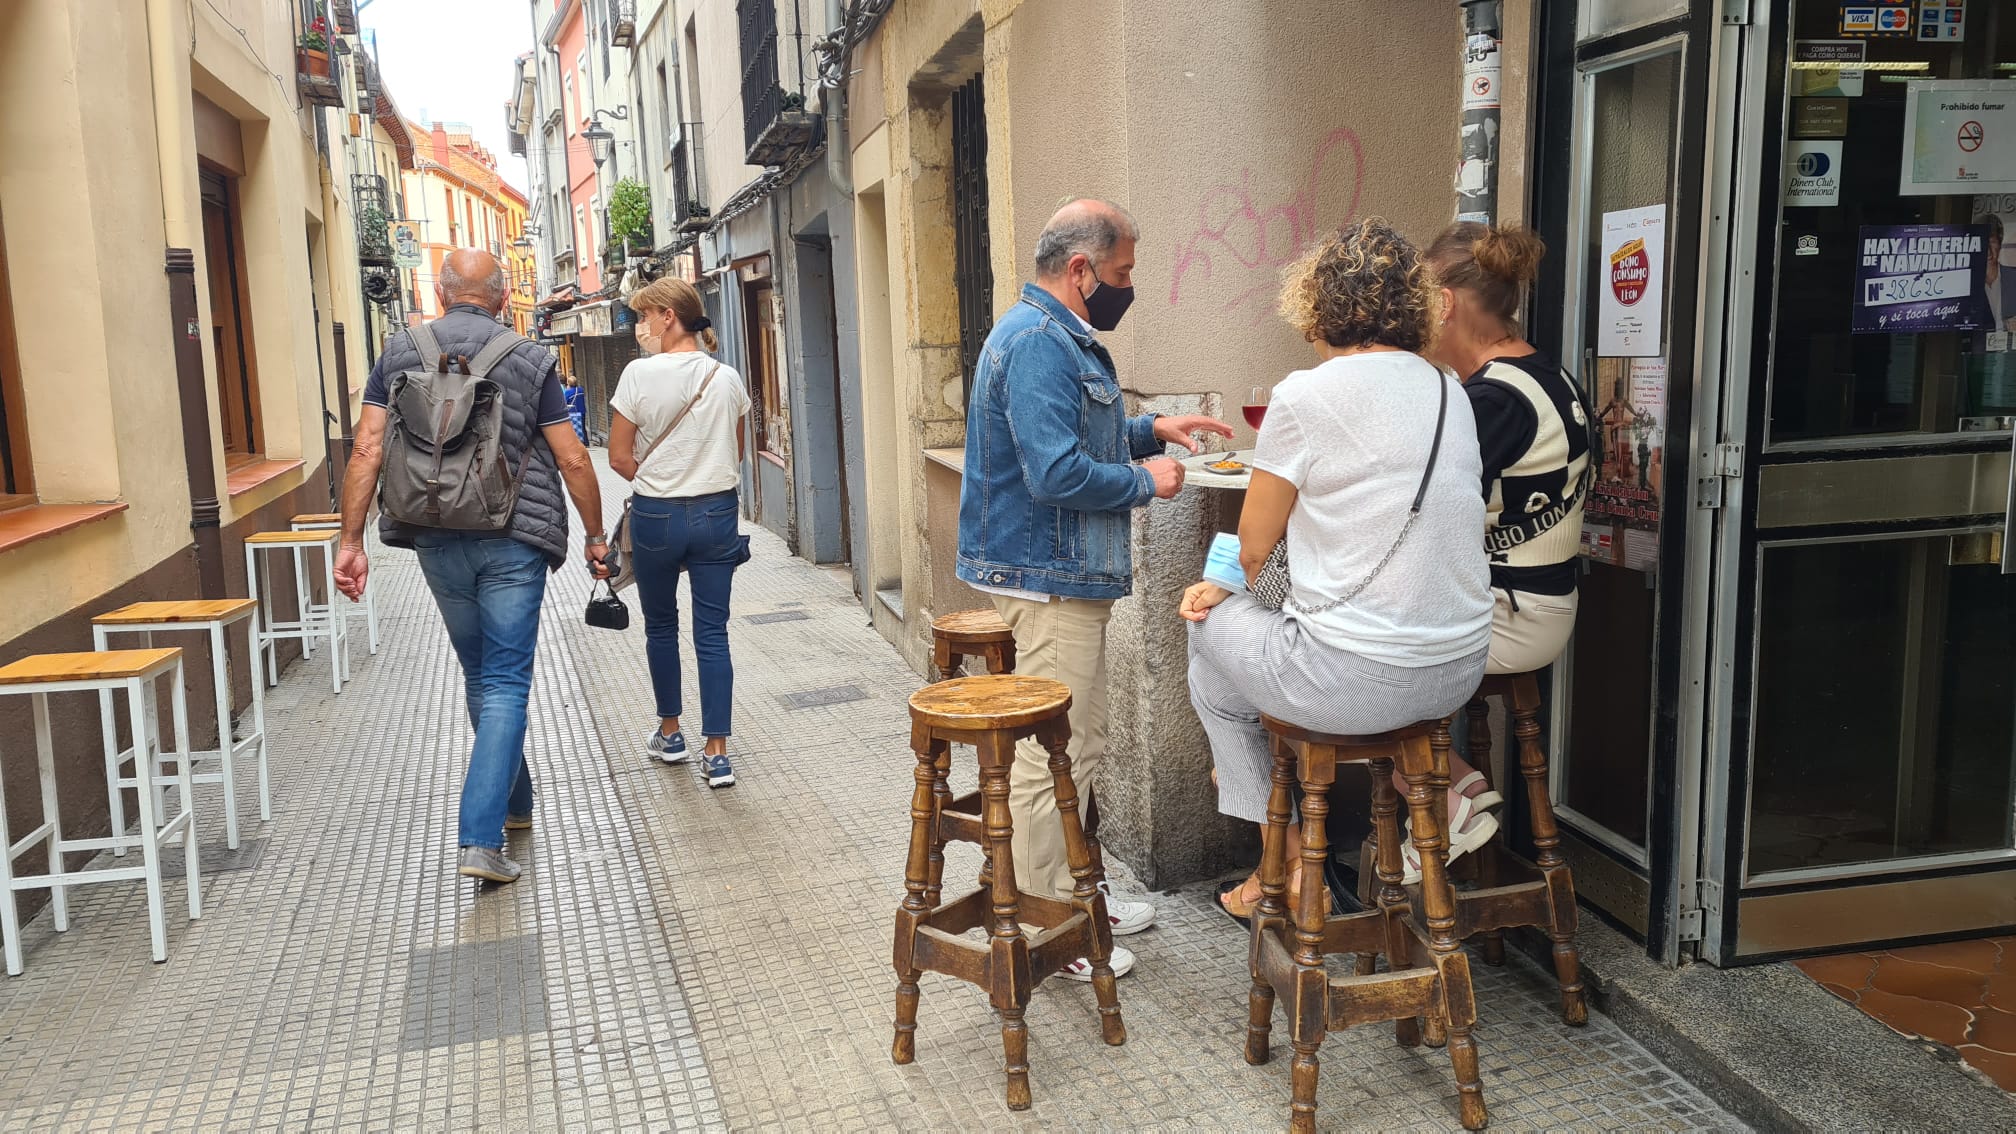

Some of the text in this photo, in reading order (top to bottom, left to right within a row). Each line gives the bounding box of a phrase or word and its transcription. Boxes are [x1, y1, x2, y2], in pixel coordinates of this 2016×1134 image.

[1851, 15, 1869, 23] VISA
[1940, 102, 2006, 111] Prohibido fumar
[1790, 177, 1834, 188] Diners Club
[1863, 233, 1982, 255] HAY LOTERÍA
[1620, 256, 1639, 269] BONO
[1862, 254, 1971, 273] DE NAVIDAD
[1613, 268, 1648, 284] CONSUMO
[1621, 286, 1638, 302] LEÓN
[1878, 315, 1888, 328] y
[1906, 308, 1930, 320] toca
[1532, 502, 1566, 536] NOT
